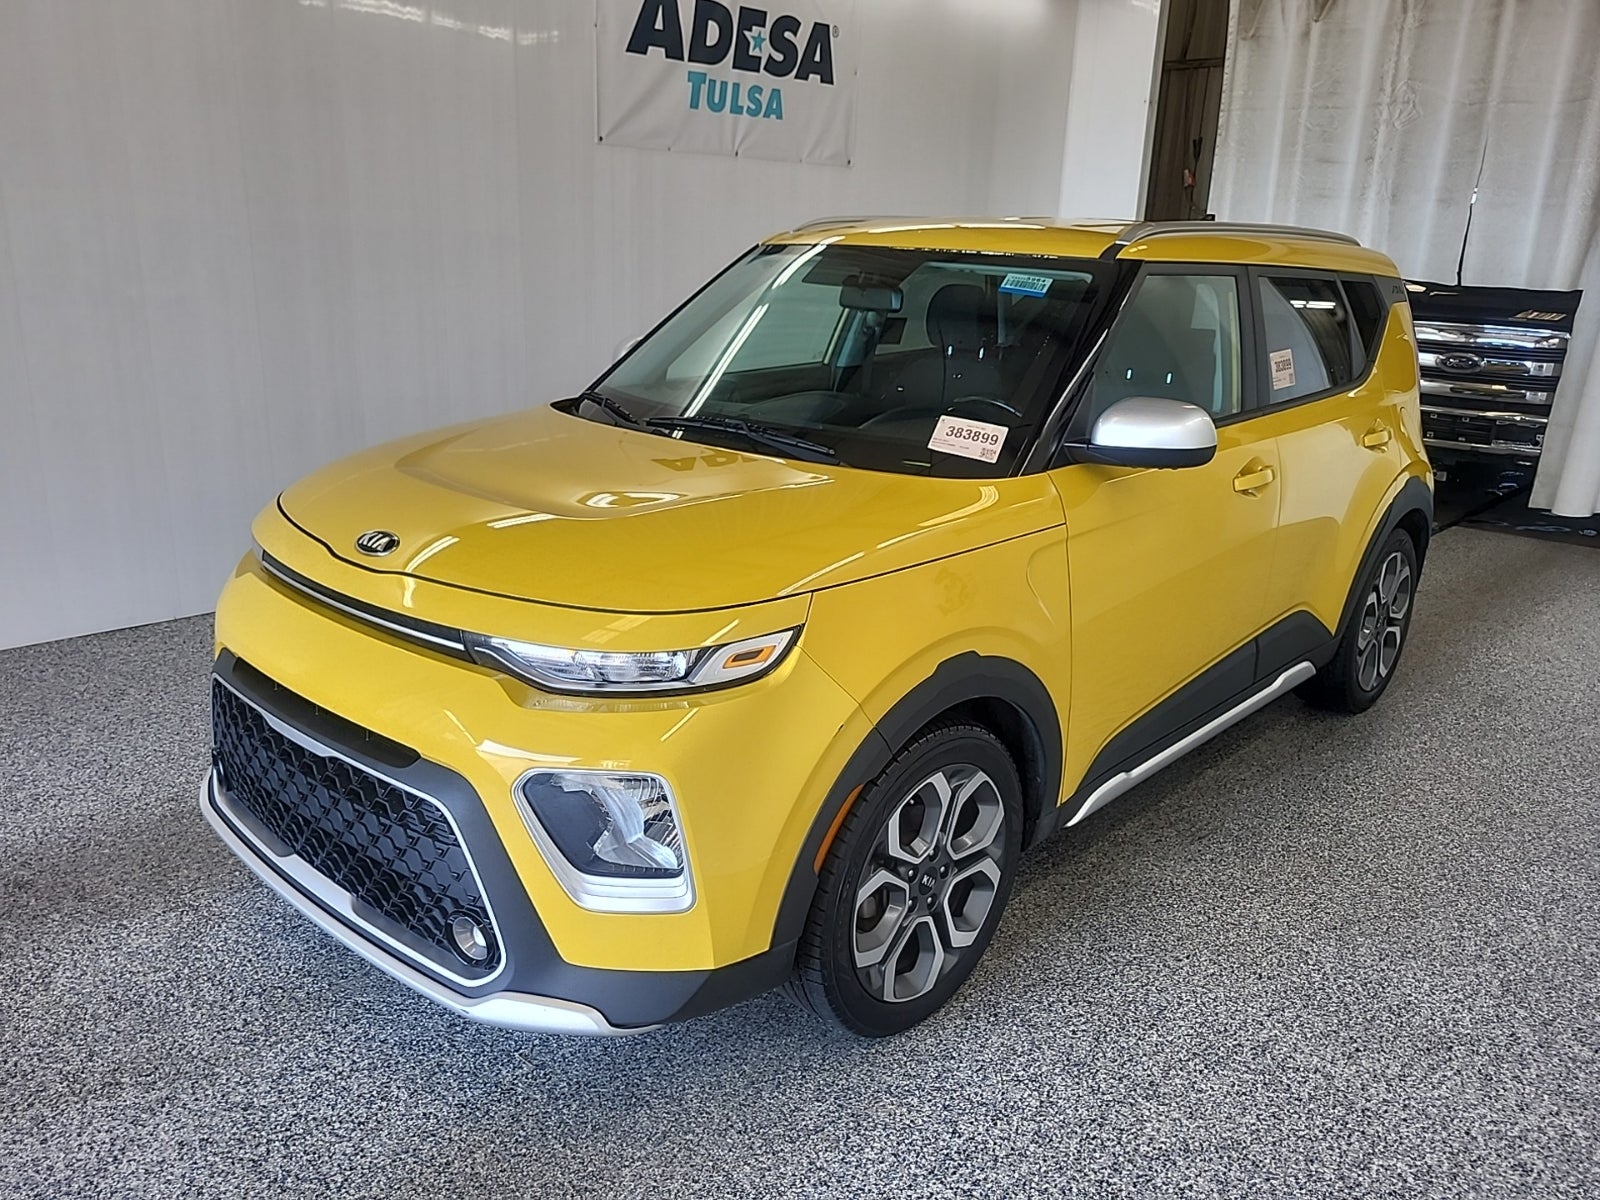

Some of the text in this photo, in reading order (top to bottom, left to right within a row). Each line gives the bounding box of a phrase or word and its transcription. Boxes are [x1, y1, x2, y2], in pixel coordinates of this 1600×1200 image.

[625, 0, 834, 85] ADESA
[688, 71, 783, 120] TULSA
[945, 425, 999, 446] 383899
[358, 532, 391, 551] KIA
[921, 874, 936, 888] KIA
